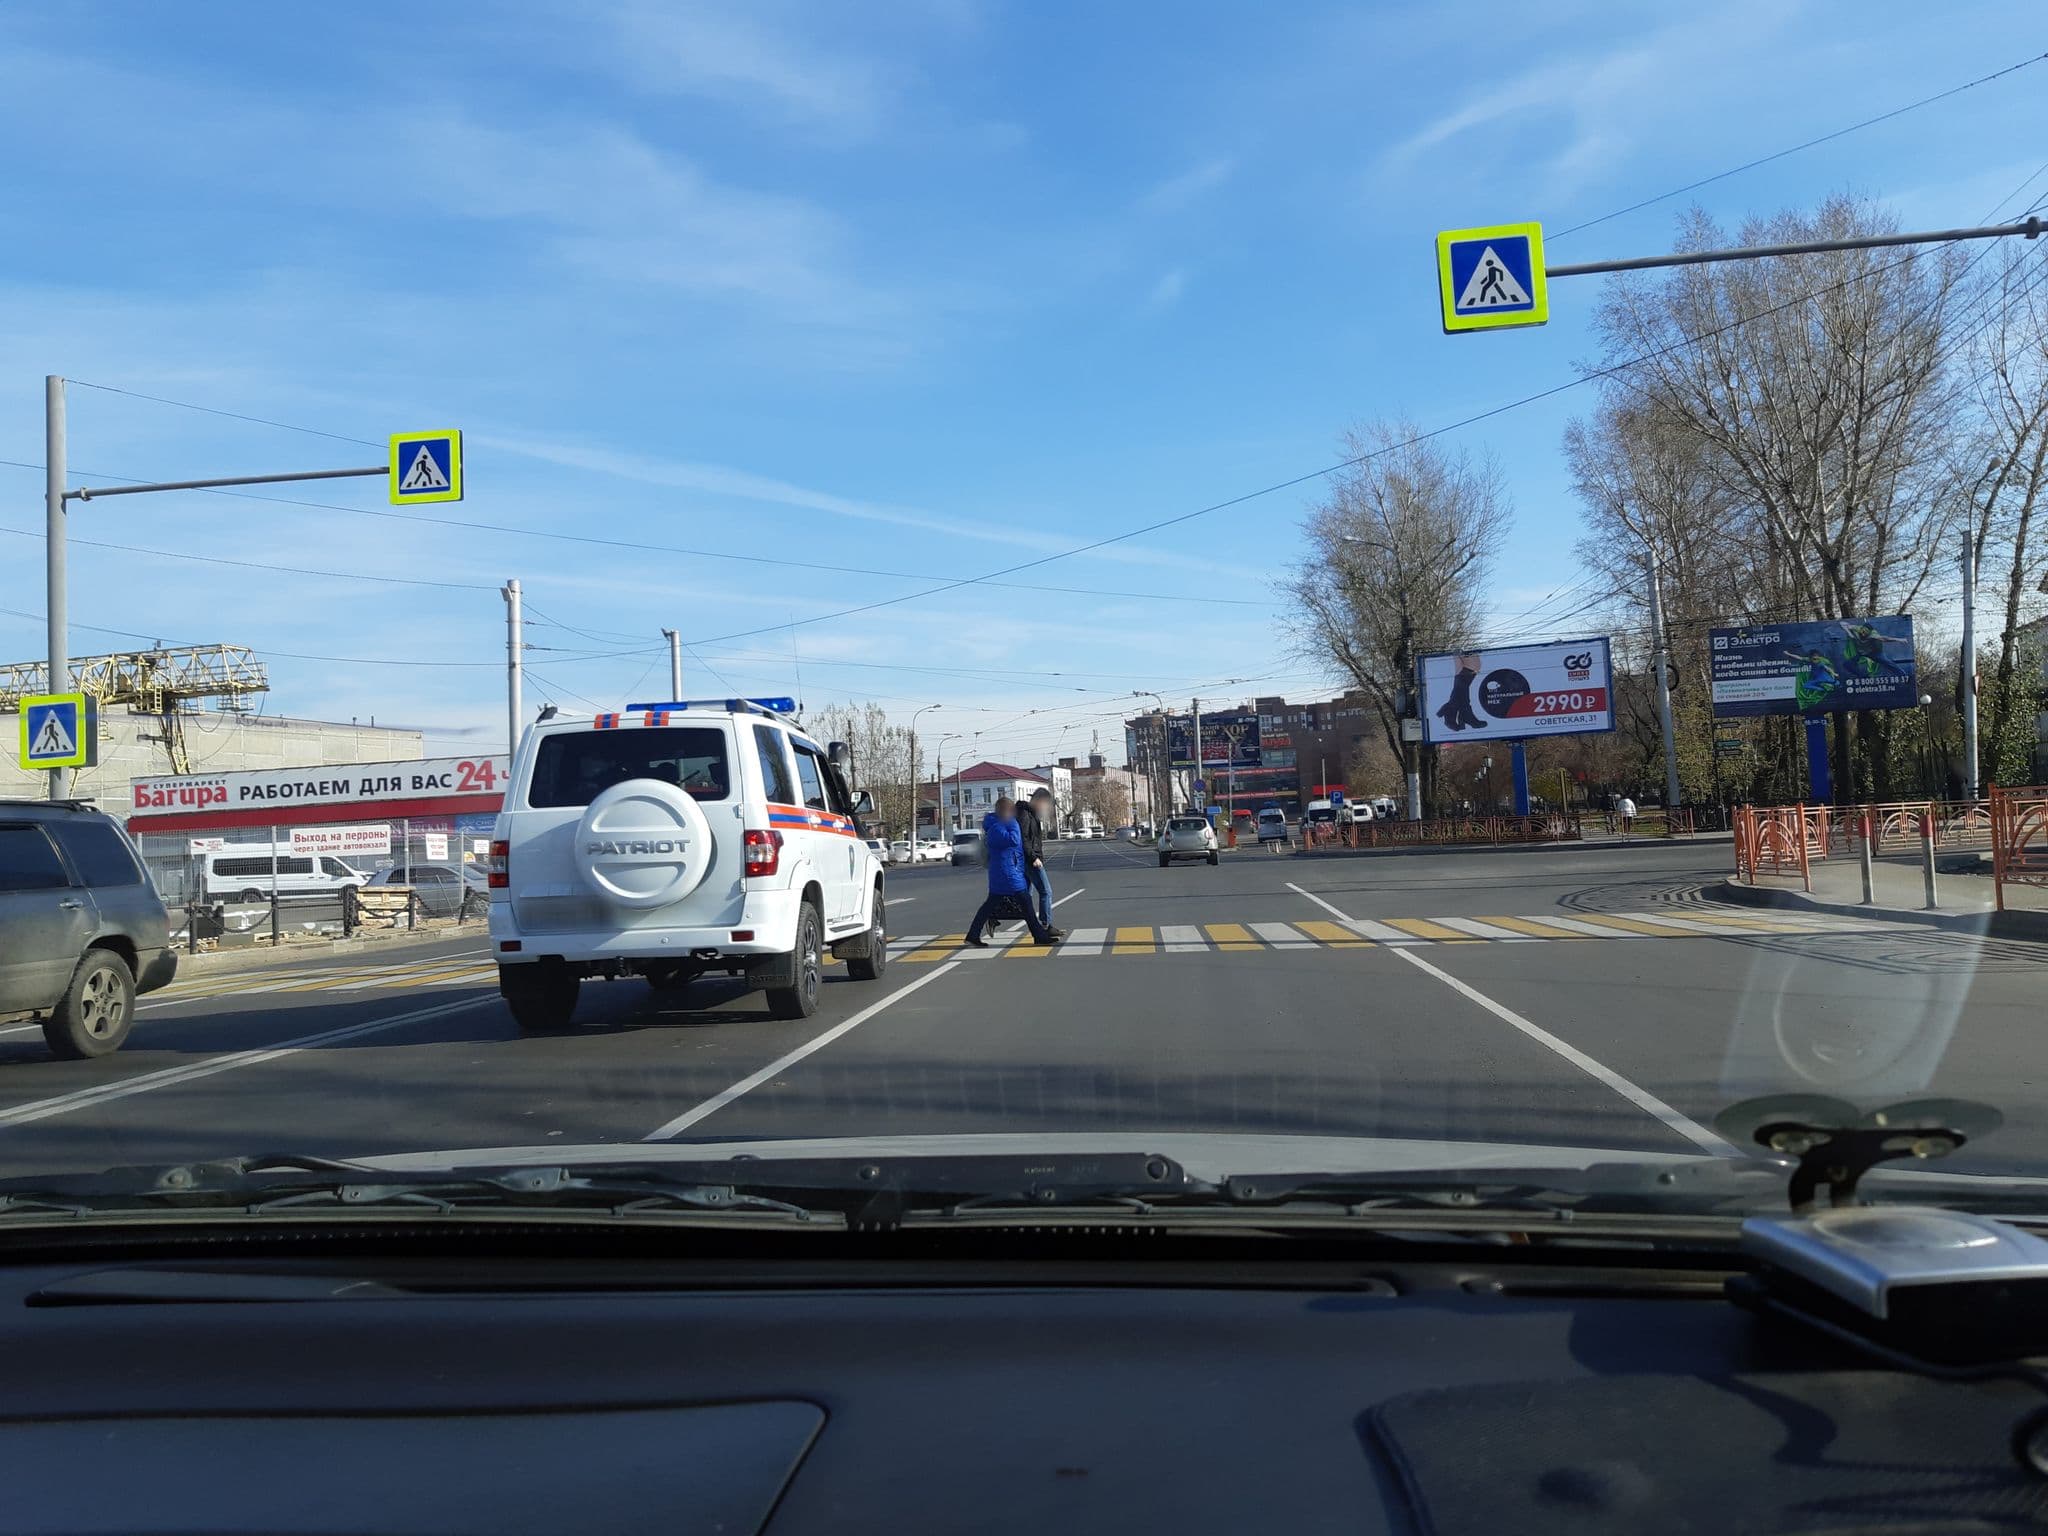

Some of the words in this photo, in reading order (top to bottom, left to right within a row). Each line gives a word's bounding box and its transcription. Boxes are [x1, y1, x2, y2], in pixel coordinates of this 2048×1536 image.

[1730, 635, 1780, 646] Электра
[1714, 654, 1743, 662] Жизнь
[1721, 660, 1755, 669] новыми
[1756, 658, 1792, 668] идеями,
[1715, 670, 1740, 679] когда
[1740, 669, 1767, 678] спина
[1768, 667, 1779, 675] не
[1854, 678, 1860, 686] 8
[1533, 693, 1582, 713] 2990
[1534, 716, 1588, 726] СОВЕТСКАЯ,
[153, 779, 227, 789] СУПЕРМАРКЕТ
[239, 779, 350, 801] РАБОТАЕМ
[359, 776, 402, 796] ДЛЯ
[412, 773, 452, 790] ВАС
[455, 760, 497, 792] 24
[134, 784, 228, 808] Багира
[294, 833, 327, 844] Выход
[330, 832, 342, 841] на
[345, 830, 388, 842] перроны
[293, 845, 314, 853] через
[316, 844, 340, 852] здание
[343, 842, 387, 850] автовокзала
[586, 838, 691, 856] PATRIOT
